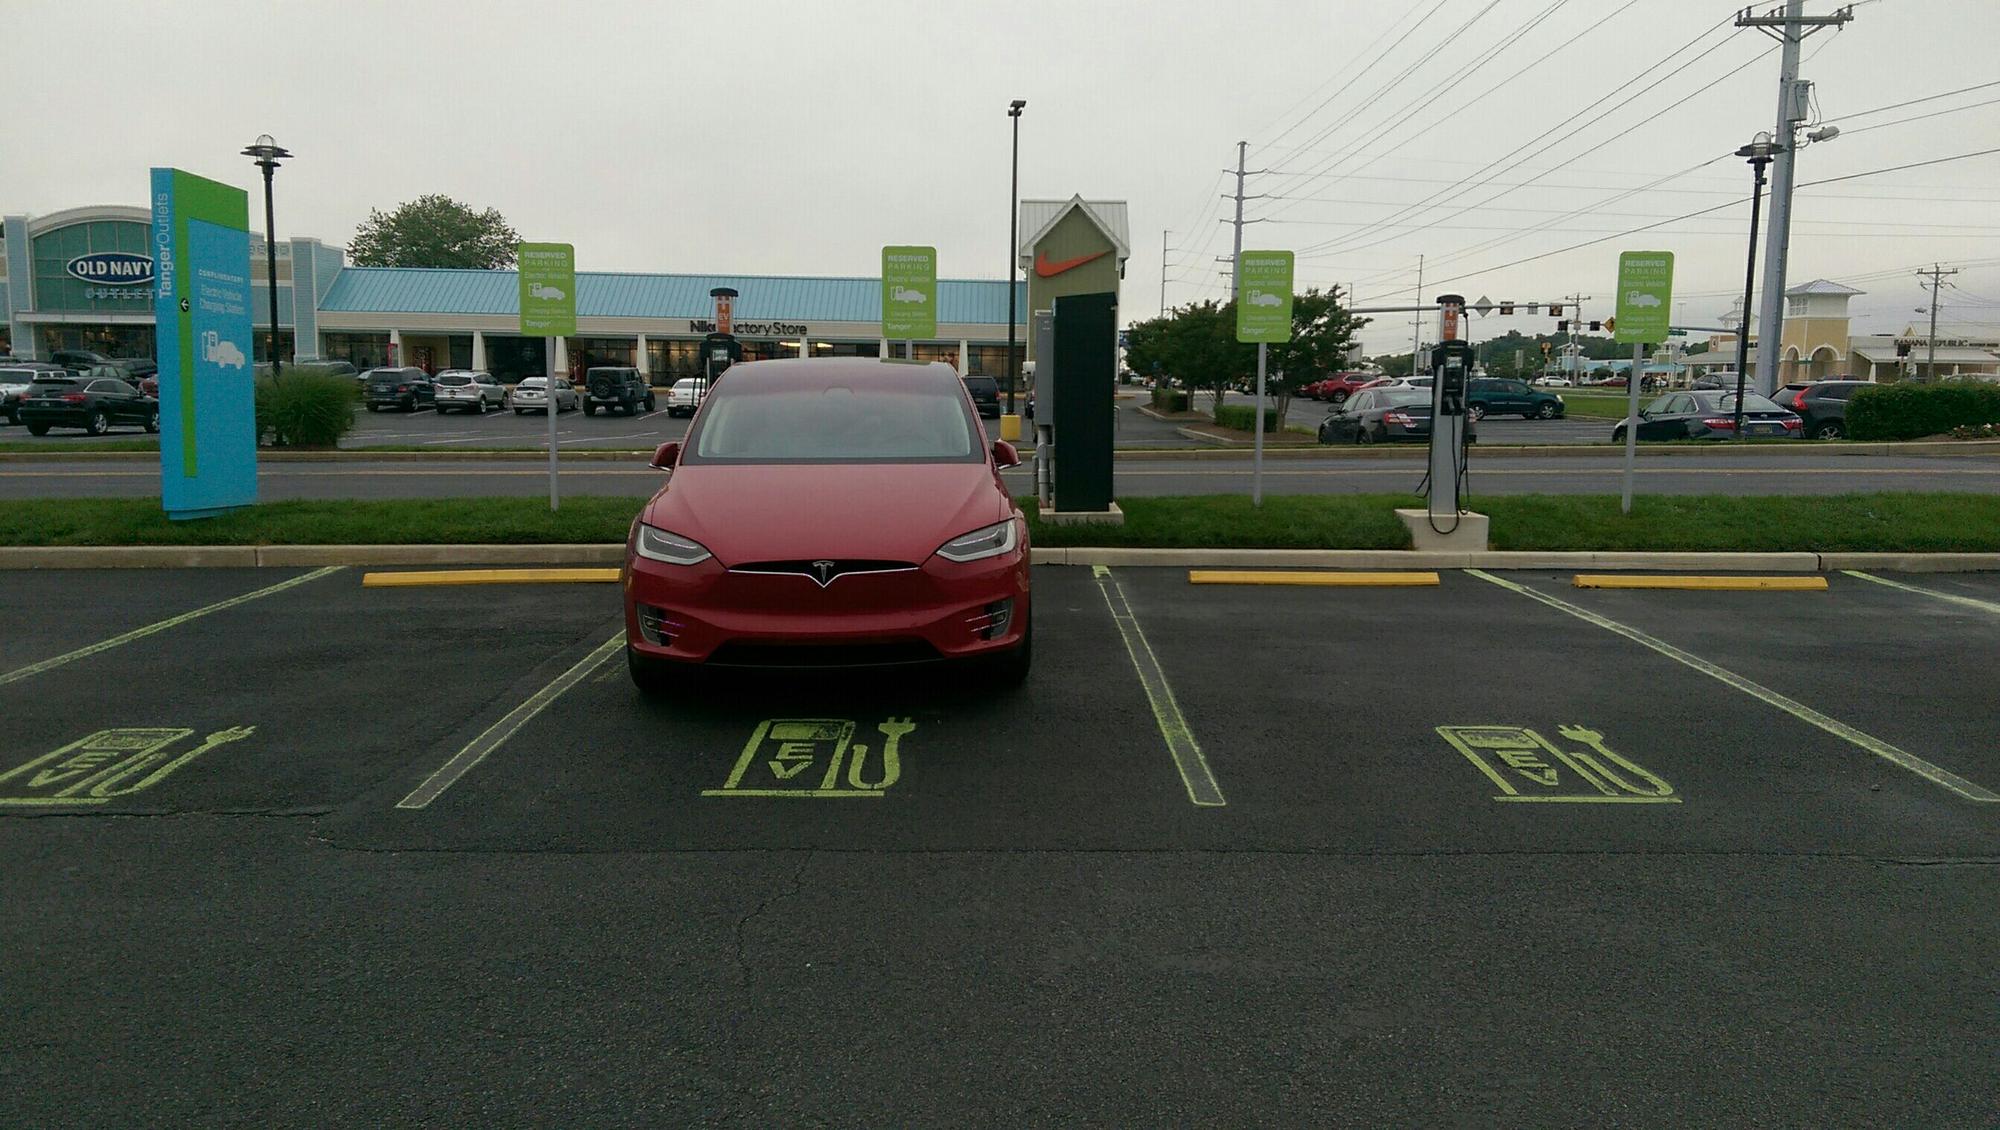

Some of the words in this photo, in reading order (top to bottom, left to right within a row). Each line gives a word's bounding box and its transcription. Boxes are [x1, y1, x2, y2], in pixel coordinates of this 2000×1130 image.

[156, 192, 173, 299] TangerOutlets
[524, 251, 567, 259] RESERVED
[76, 261, 107, 275] OLD
[110, 261, 152, 276] NAVY
[524, 260, 569, 268] PARKING
[773, 321, 808, 335] Store
